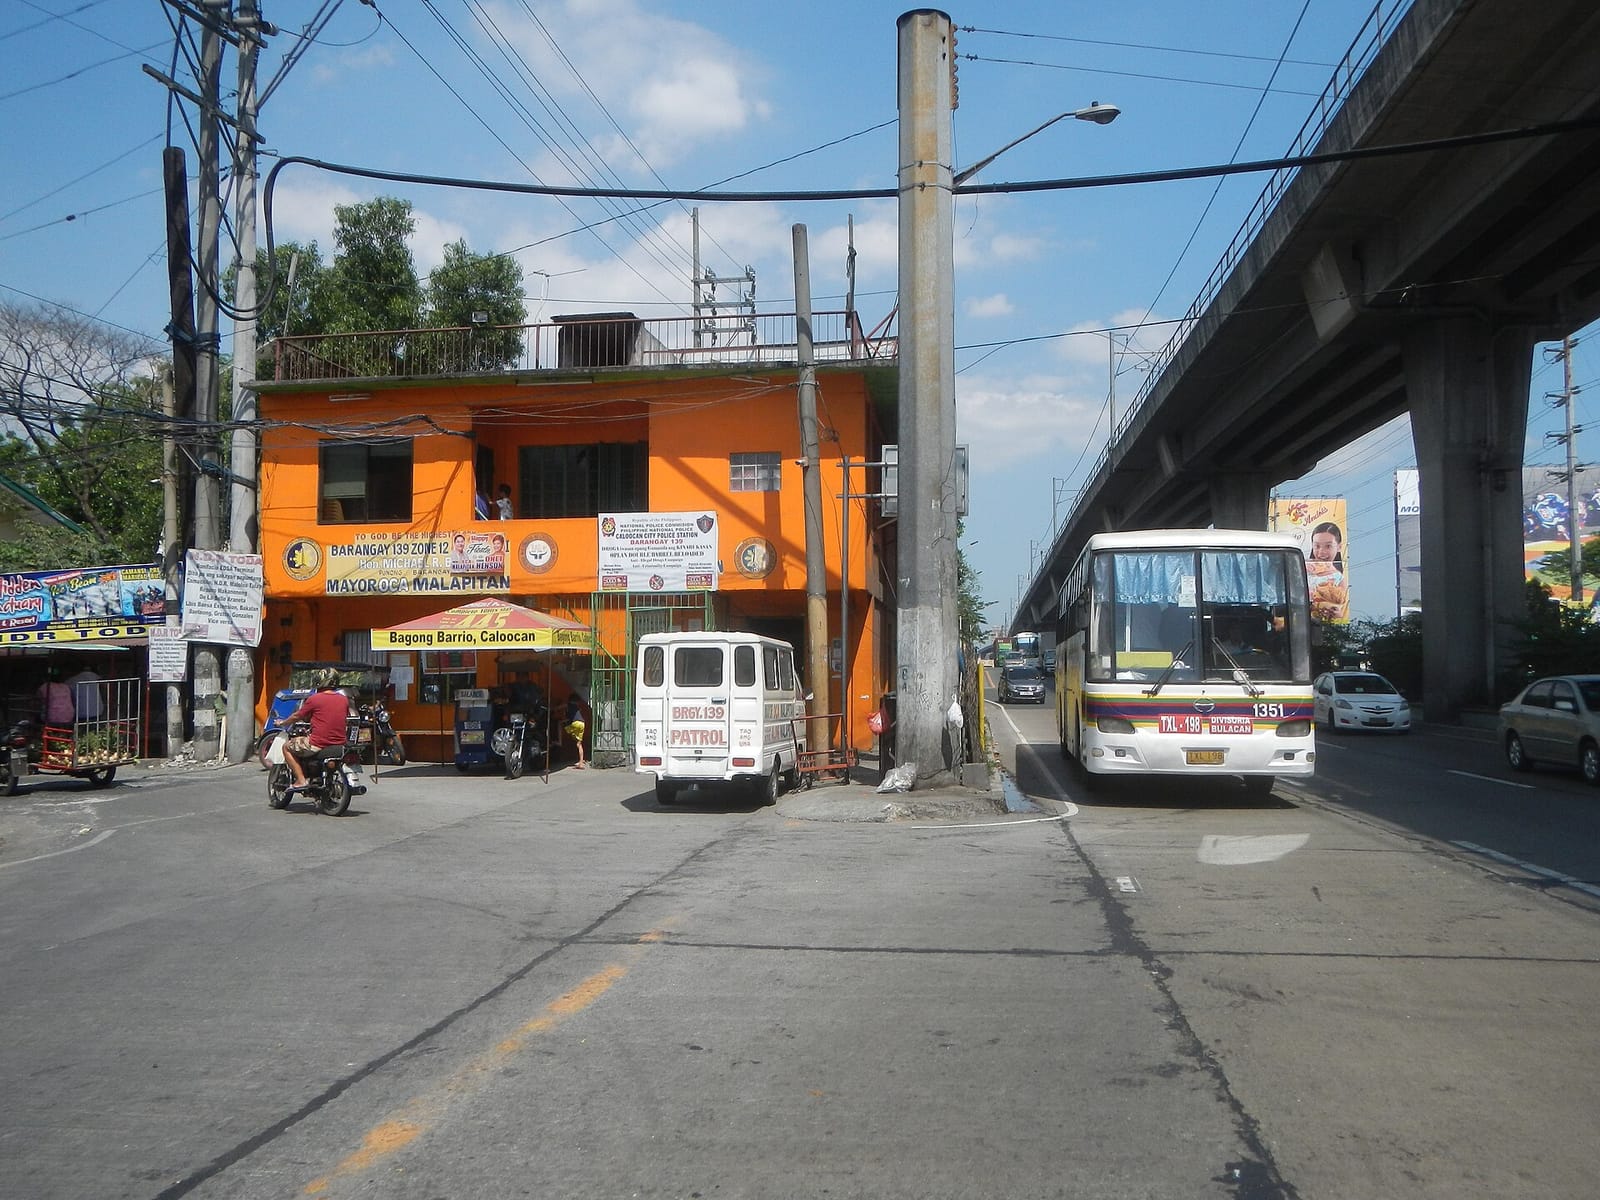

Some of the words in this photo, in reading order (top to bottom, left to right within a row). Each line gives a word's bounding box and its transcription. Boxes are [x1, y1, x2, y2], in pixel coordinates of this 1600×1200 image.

[355, 533, 366, 541] TO
[370, 533, 388, 541] GOD
[405, 532, 419, 540] THE
[331, 543, 391, 557] BARANGAY
[393, 543, 409, 555] 139
[411, 542, 437, 555] ZONE
[439, 541, 449, 554] 12
[229, 555, 264, 566] TODA
[383, 556, 430, 569] MICHAEL
[432, 557, 442, 568] R.
[327, 578, 377, 593] MAYOR
[378, 576, 410, 593] OCA
[413, 575, 511, 592] MALAPITAN
[389, 631, 433, 646] Bagong
[437, 631, 477, 645] Barrio,
[480, 630, 536, 643] Caloocan
[1252, 703, 1284, 718] 1351
[1160, 715, 1178, 732] TXL
[1185, 716, 1200, 733] 198
[1211, 717, 1251, 725] DIVISORIA
[1211, 725, 1251, 733] BULACAN
[670, 729, 727, 746] PATROL
